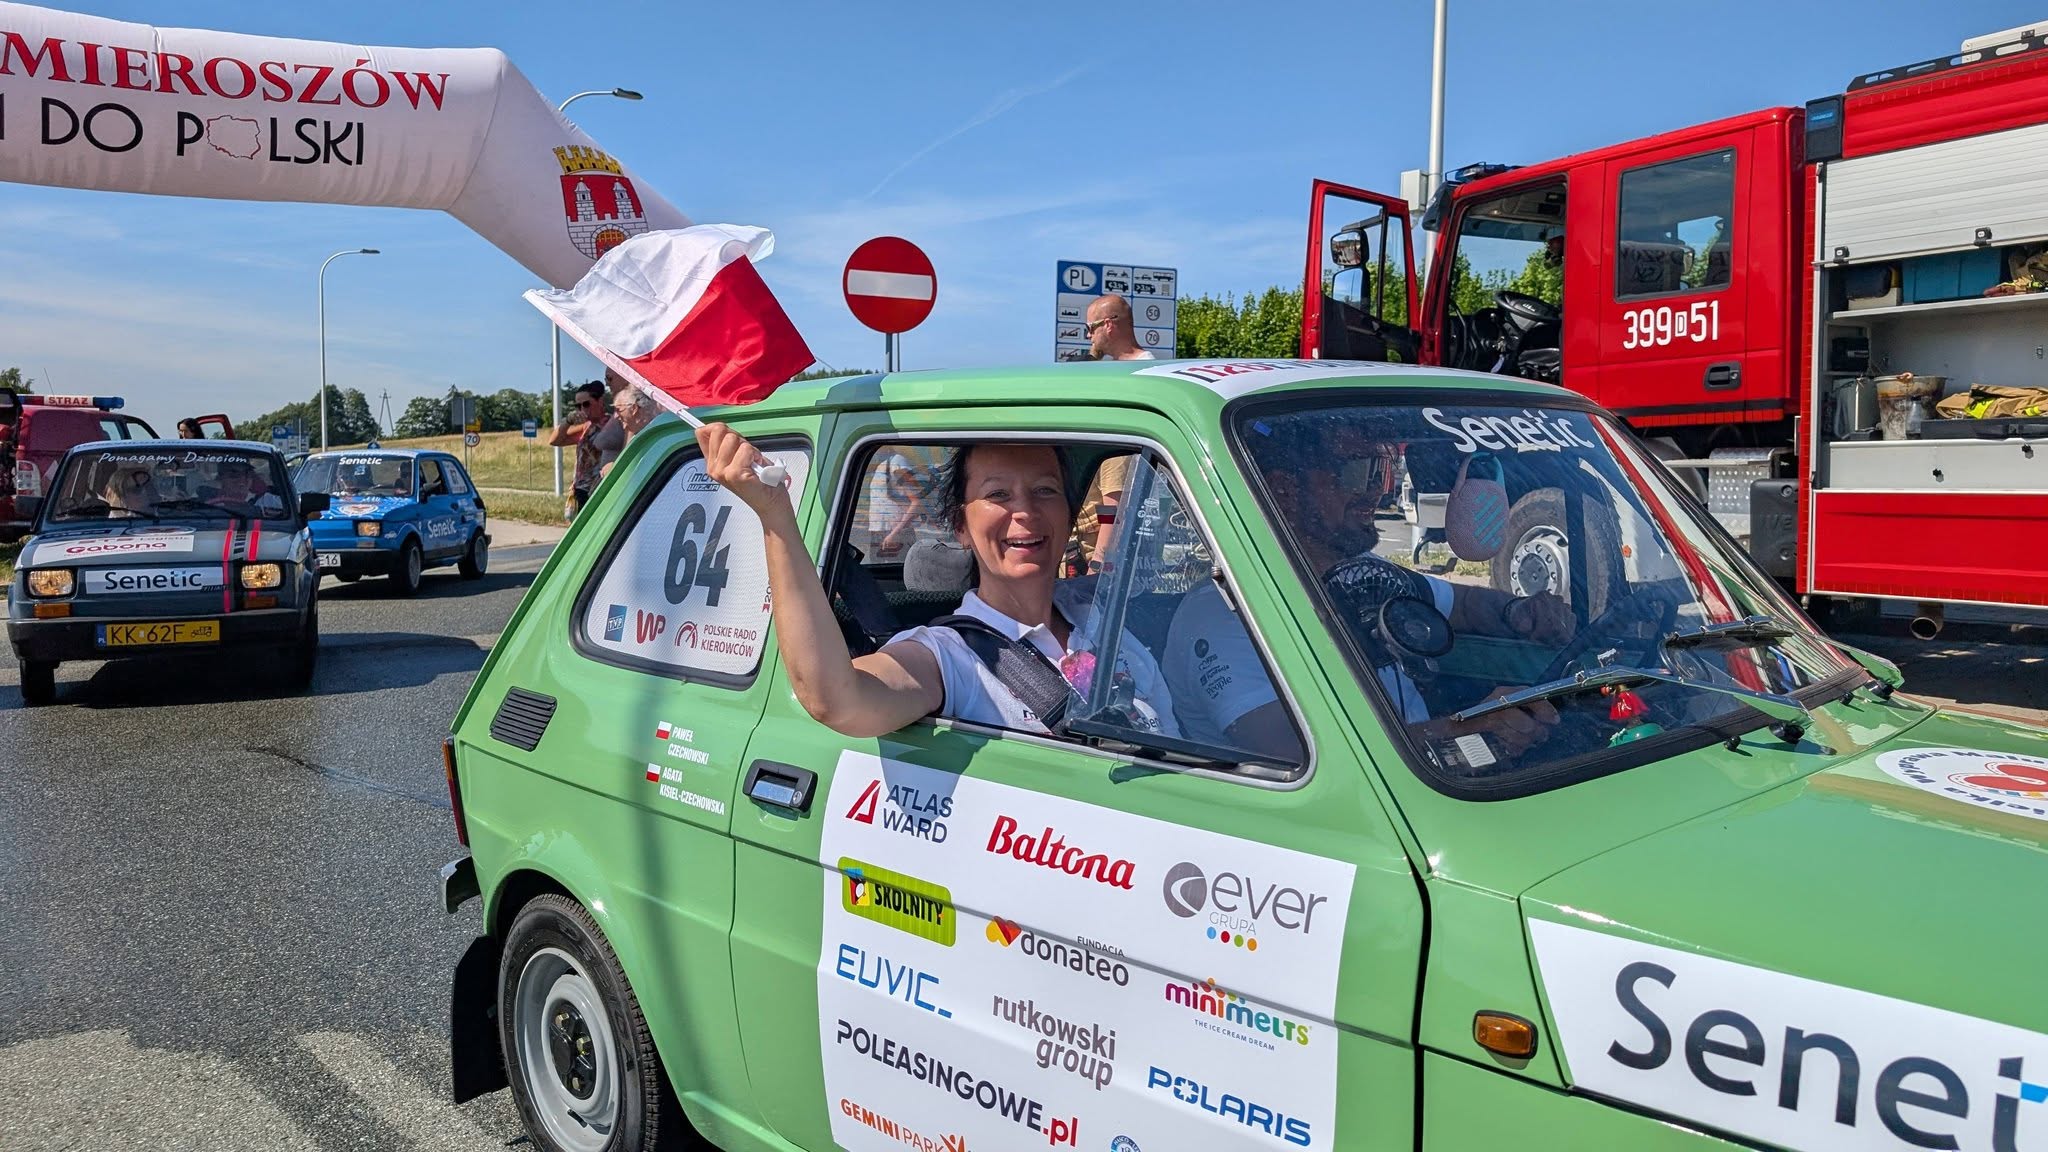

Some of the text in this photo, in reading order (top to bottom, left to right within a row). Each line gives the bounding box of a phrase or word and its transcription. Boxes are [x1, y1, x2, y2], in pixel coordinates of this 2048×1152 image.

[0, 31, 450, 111] MIEROSZÓW
[42, 97, 144, 153] DO
[1070, 269, 1090, 287] PL
[1422, 408, 1595, 453] Senetic
[99, 452, 248, 464] Pomagamy Dzieciom
[339, 457, 382, 465] Senetic
[427, 519, 457, 538] Senetic
[66, 543, 167, 554] Gabona
[663, 502, 733, 607] 64
[104, 570, 203, 590] Senetic
[111, 623, 186, 645] KK 62F
[608, 616, 624, 631] TVP
[636, 609, 666, 644] WP
[704, 624, 757, 641] POLSKIE RADIO
[701, 640, 754, 657] KIEROWCÓW
[671, 726, 694, 742] PAWEŁ
[668, 743, 710, 765] CZECHOWSKI
[662, 767, 683, 783] AGATA
[659, 784, 725, 815] KISIEL-CZECHOWSKA
[885, 783, 954, 818] ATLAS
[882, 808, 948, 844] WARD
[986, 816, 1136, 891] Baltona
[874, 883, 944, 925] SKOLNITY
[1211, 871, 1328, 934] ever
[1209, 911, 1257, 936] GRUPA
[1020, 930, 1129, 986] donateo
[993, 995, 1116, 1060] rutkowski
[1194, 1019, 1275, 1051] THE ICE CREAM DREAM
[1035, 1038, 1113, 1090] group
[836, 1020, 1078, 1147] POLEASINGOWE.pl
[1148, 1066, 1311, 1147] POLARIS
[841, 1099, 945, 1152] GEMINI PARK
